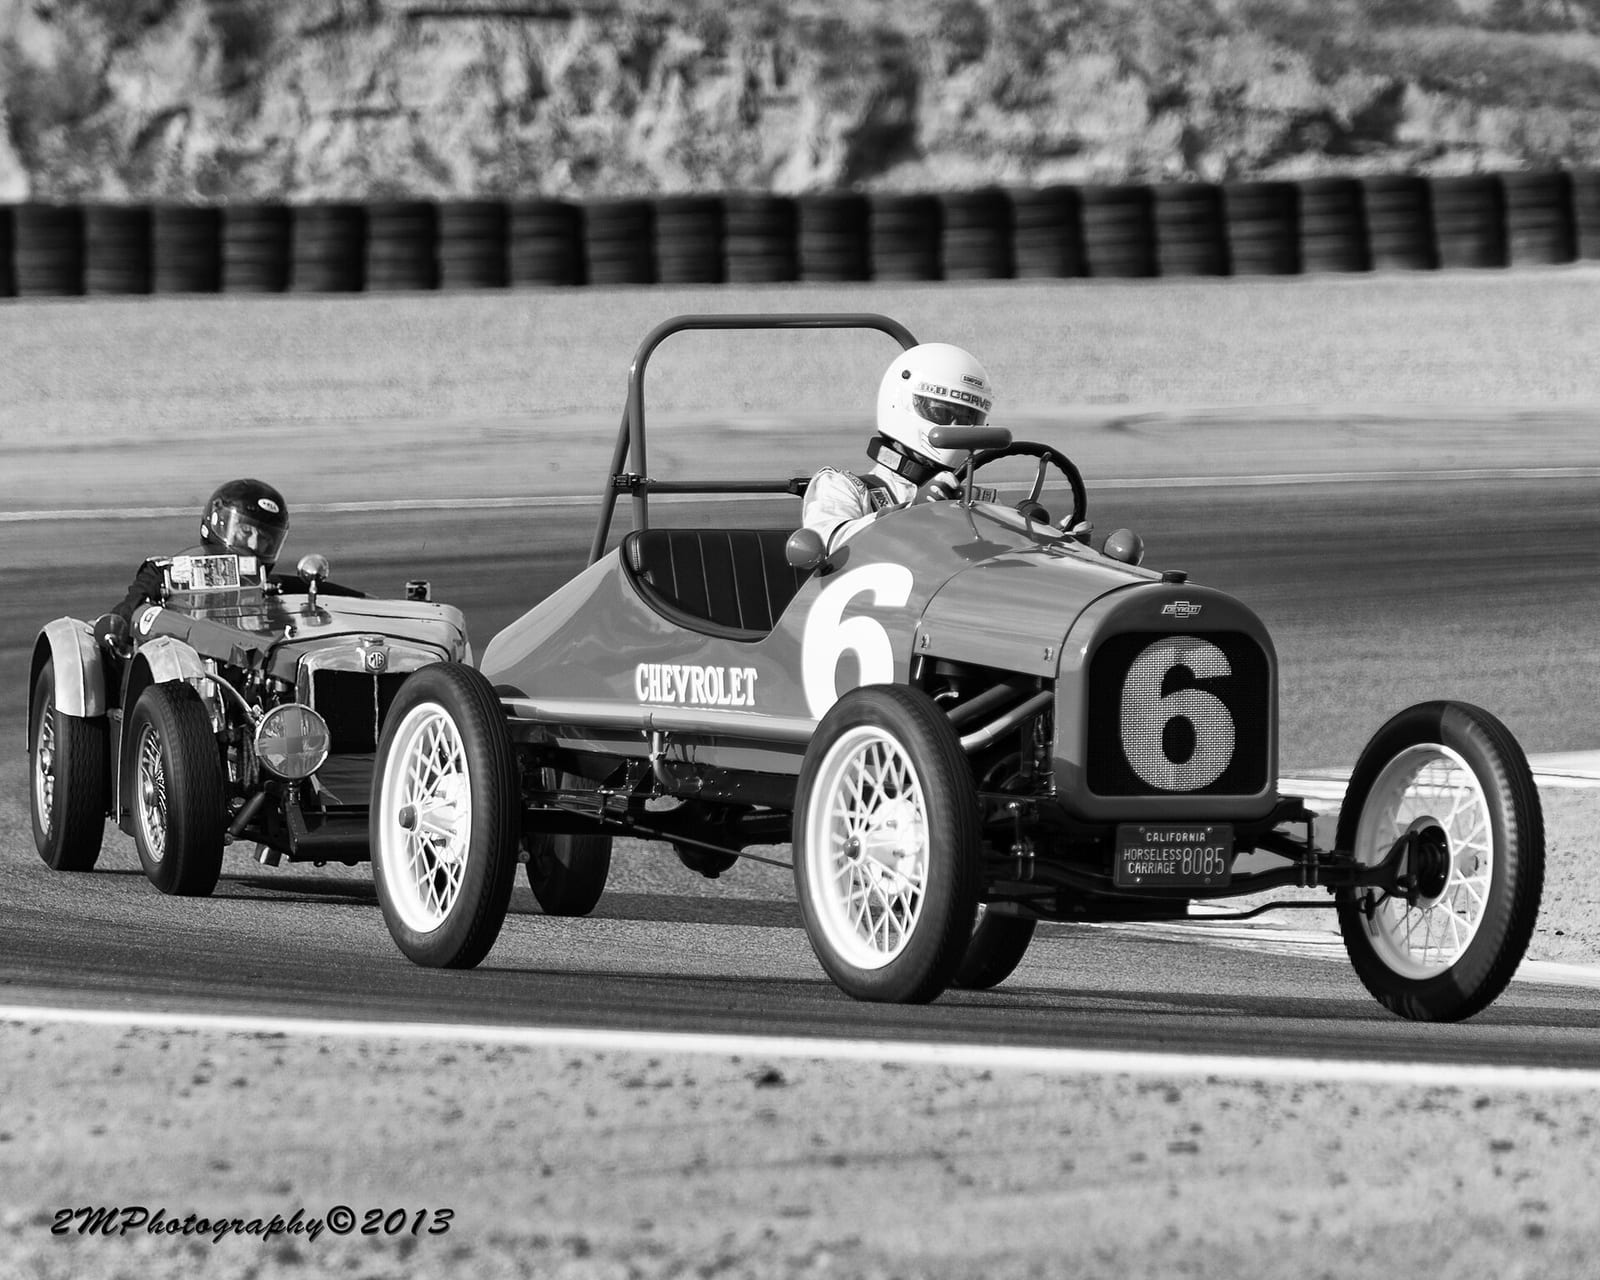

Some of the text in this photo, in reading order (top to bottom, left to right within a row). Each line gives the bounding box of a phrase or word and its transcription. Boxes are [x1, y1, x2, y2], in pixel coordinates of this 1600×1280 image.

[801, 562, 914, 722] 6
[635, 662, 758, 706] CHEVROLET
[1120, 635, 1236, 792] 6
[1146, 832, 1206, 842] CALIFORNIA
[1123, 847, 1225, 875] HORSELESS 8085
[1127, 862, 1176, 874] CARRIAGE
